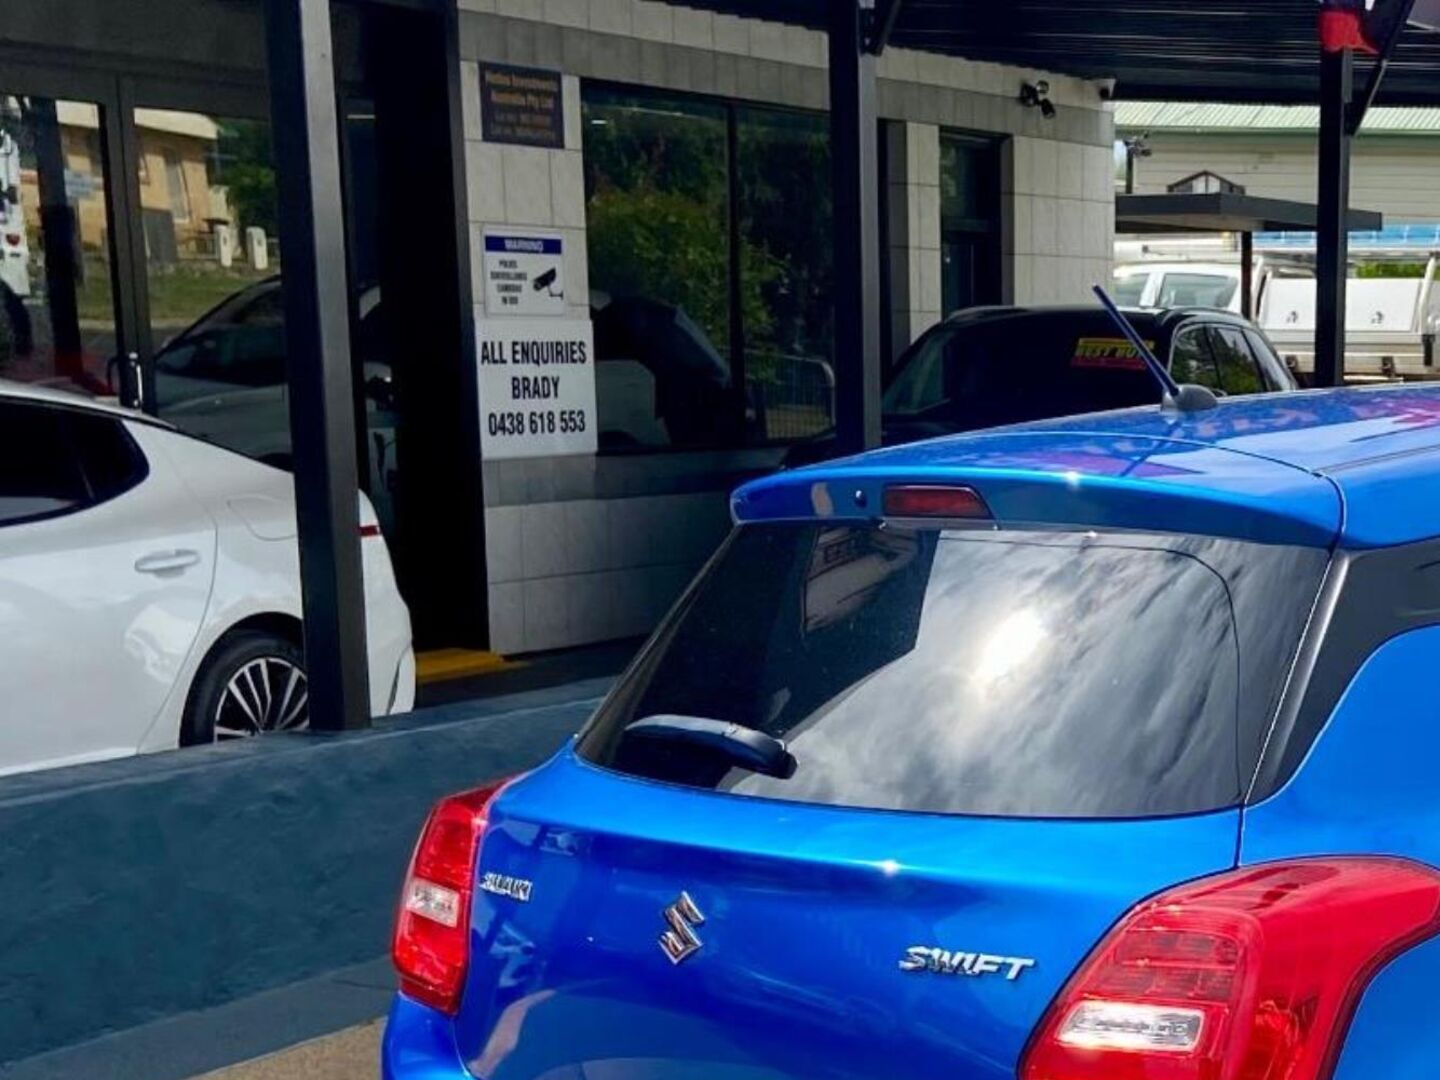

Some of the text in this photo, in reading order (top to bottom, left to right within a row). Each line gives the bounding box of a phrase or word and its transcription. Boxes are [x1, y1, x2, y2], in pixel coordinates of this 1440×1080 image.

[481, 340, 587, 366] ALL ENQUIRIES
[1074, 342, 1111, 359] BEST
[511, 375, 560, 400] BRADY
[488, 409, 586, 436] 0438 618 553
[898, 945, 1036, 980] SWIFT
